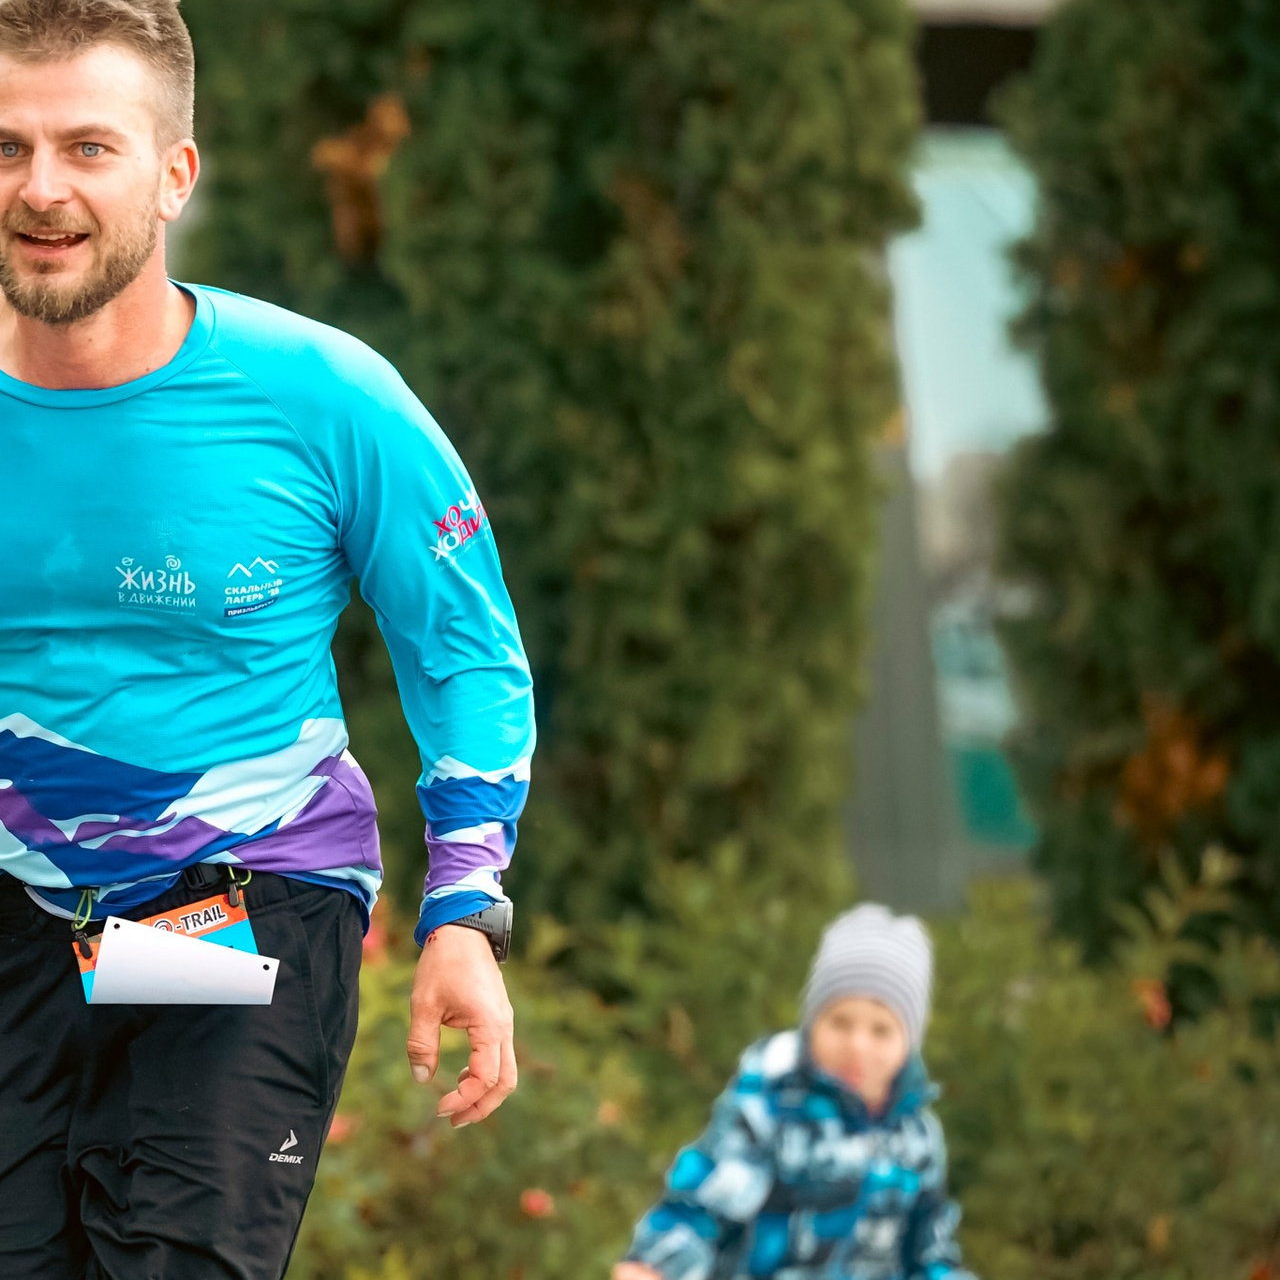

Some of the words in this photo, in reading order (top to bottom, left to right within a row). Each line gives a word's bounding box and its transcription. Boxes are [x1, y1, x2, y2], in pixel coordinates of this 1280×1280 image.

[114, 565, 196, 595] ЖИЗНЬ
[224, 578, 283, 596] СКАЛЬНЫЙ
[117, 592, 126, 602] В
[129, 593, 197, 608] ДВИЖЕНИИ
[224, 593, 264, 605] ЛАГЕРЬ
[269, 1152, 304, 1165] DEMIX
